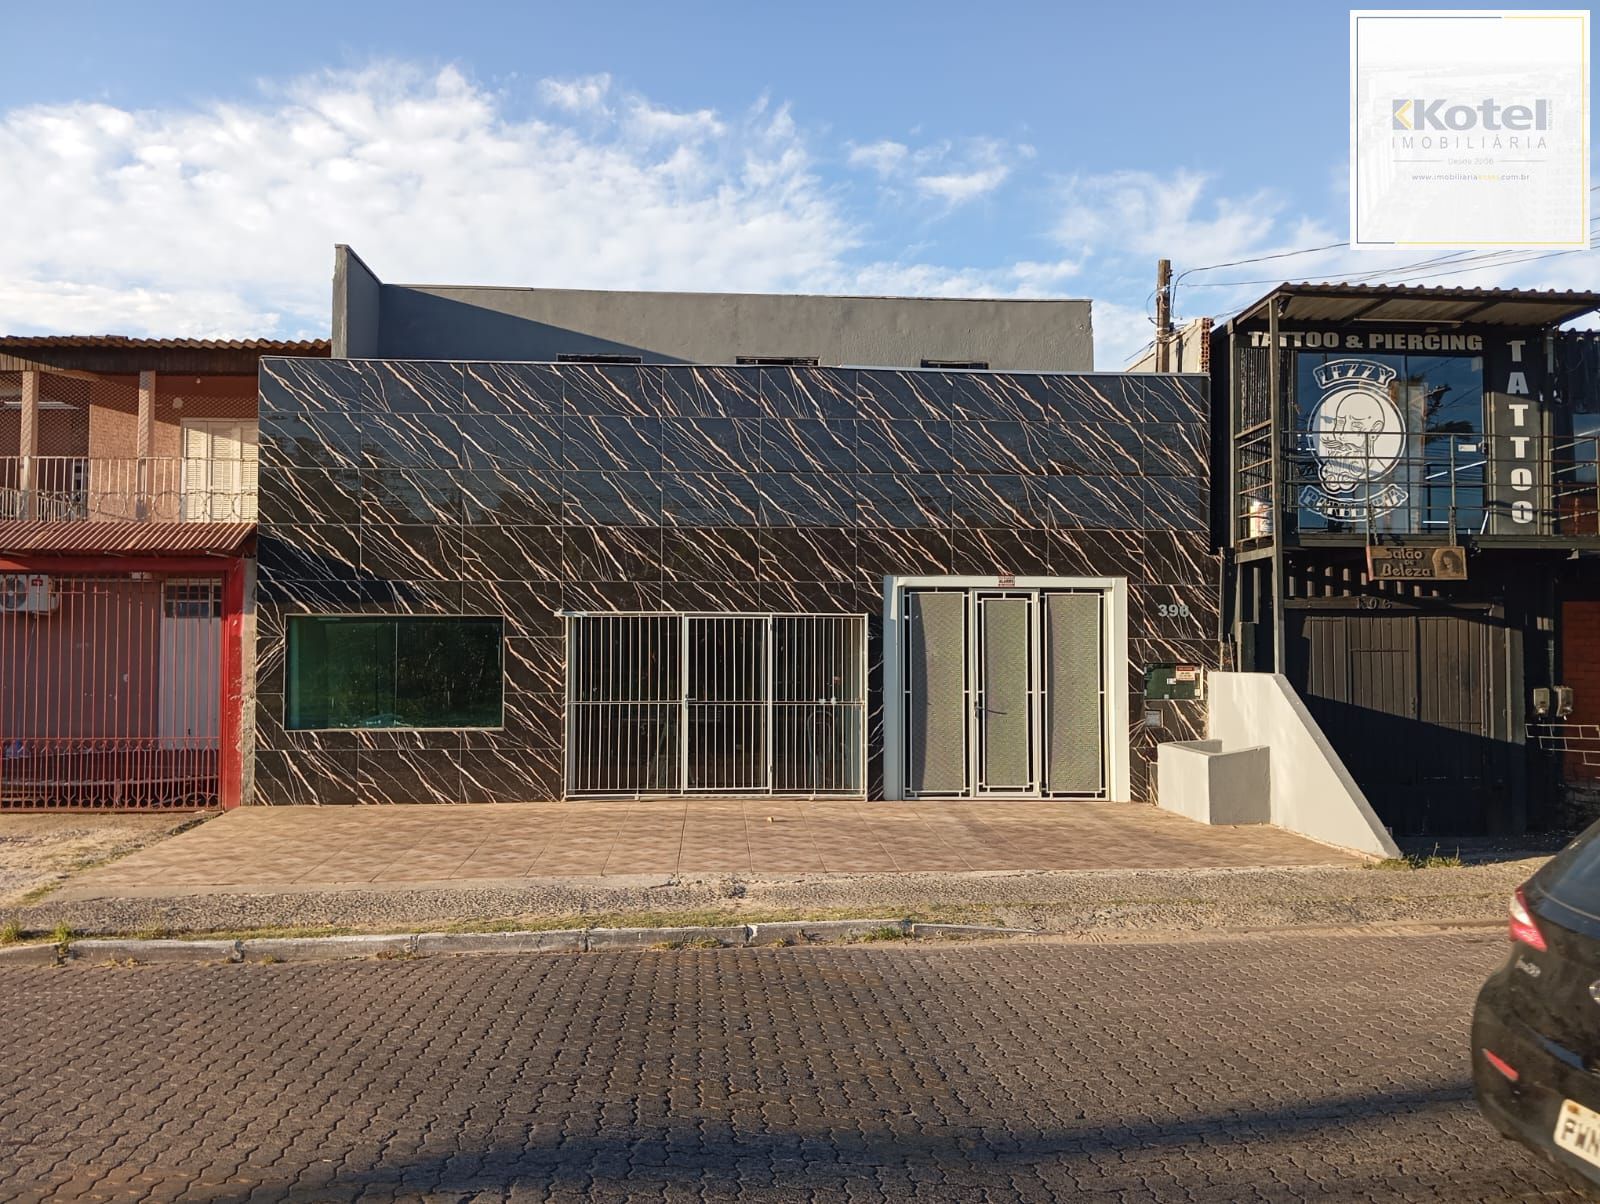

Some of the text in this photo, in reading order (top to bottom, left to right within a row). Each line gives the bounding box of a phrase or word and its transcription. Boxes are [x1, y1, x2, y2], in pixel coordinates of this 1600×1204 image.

[1248, 331, 1483, 350] TATTOO & PIERCING
[1506, 340, 1533, 524] TATTOO
[1381, 563, 1431, 577] Beleza
